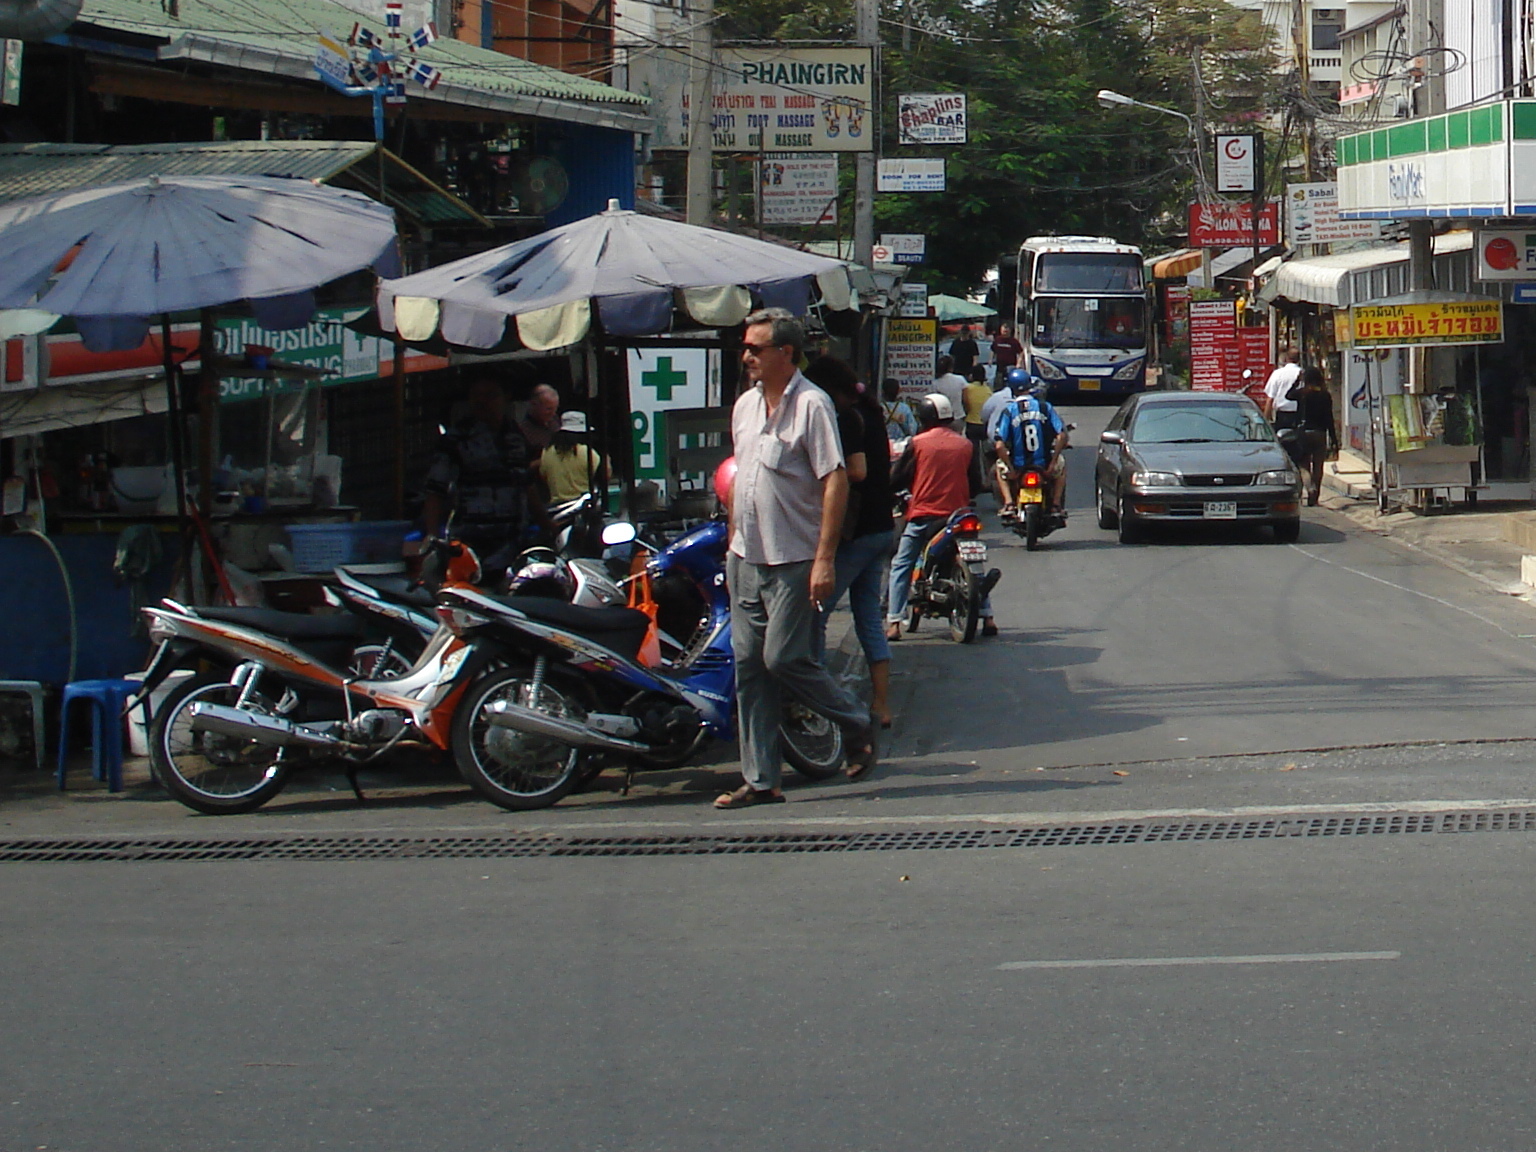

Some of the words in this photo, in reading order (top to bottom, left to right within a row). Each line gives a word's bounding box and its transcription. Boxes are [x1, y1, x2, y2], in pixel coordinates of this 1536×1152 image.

[784, 95, 815, 108] MASSAGE
[901, 96, 963, 127] Chaplins
[748, 114, 769, 127] FOOT
[777, 114, 815, 127] MASSAGE
[937, 113, 964, 126] BAR
[775, 134, 812, 146] MASSAGE
[1024, 424, 1040, 452] 8
